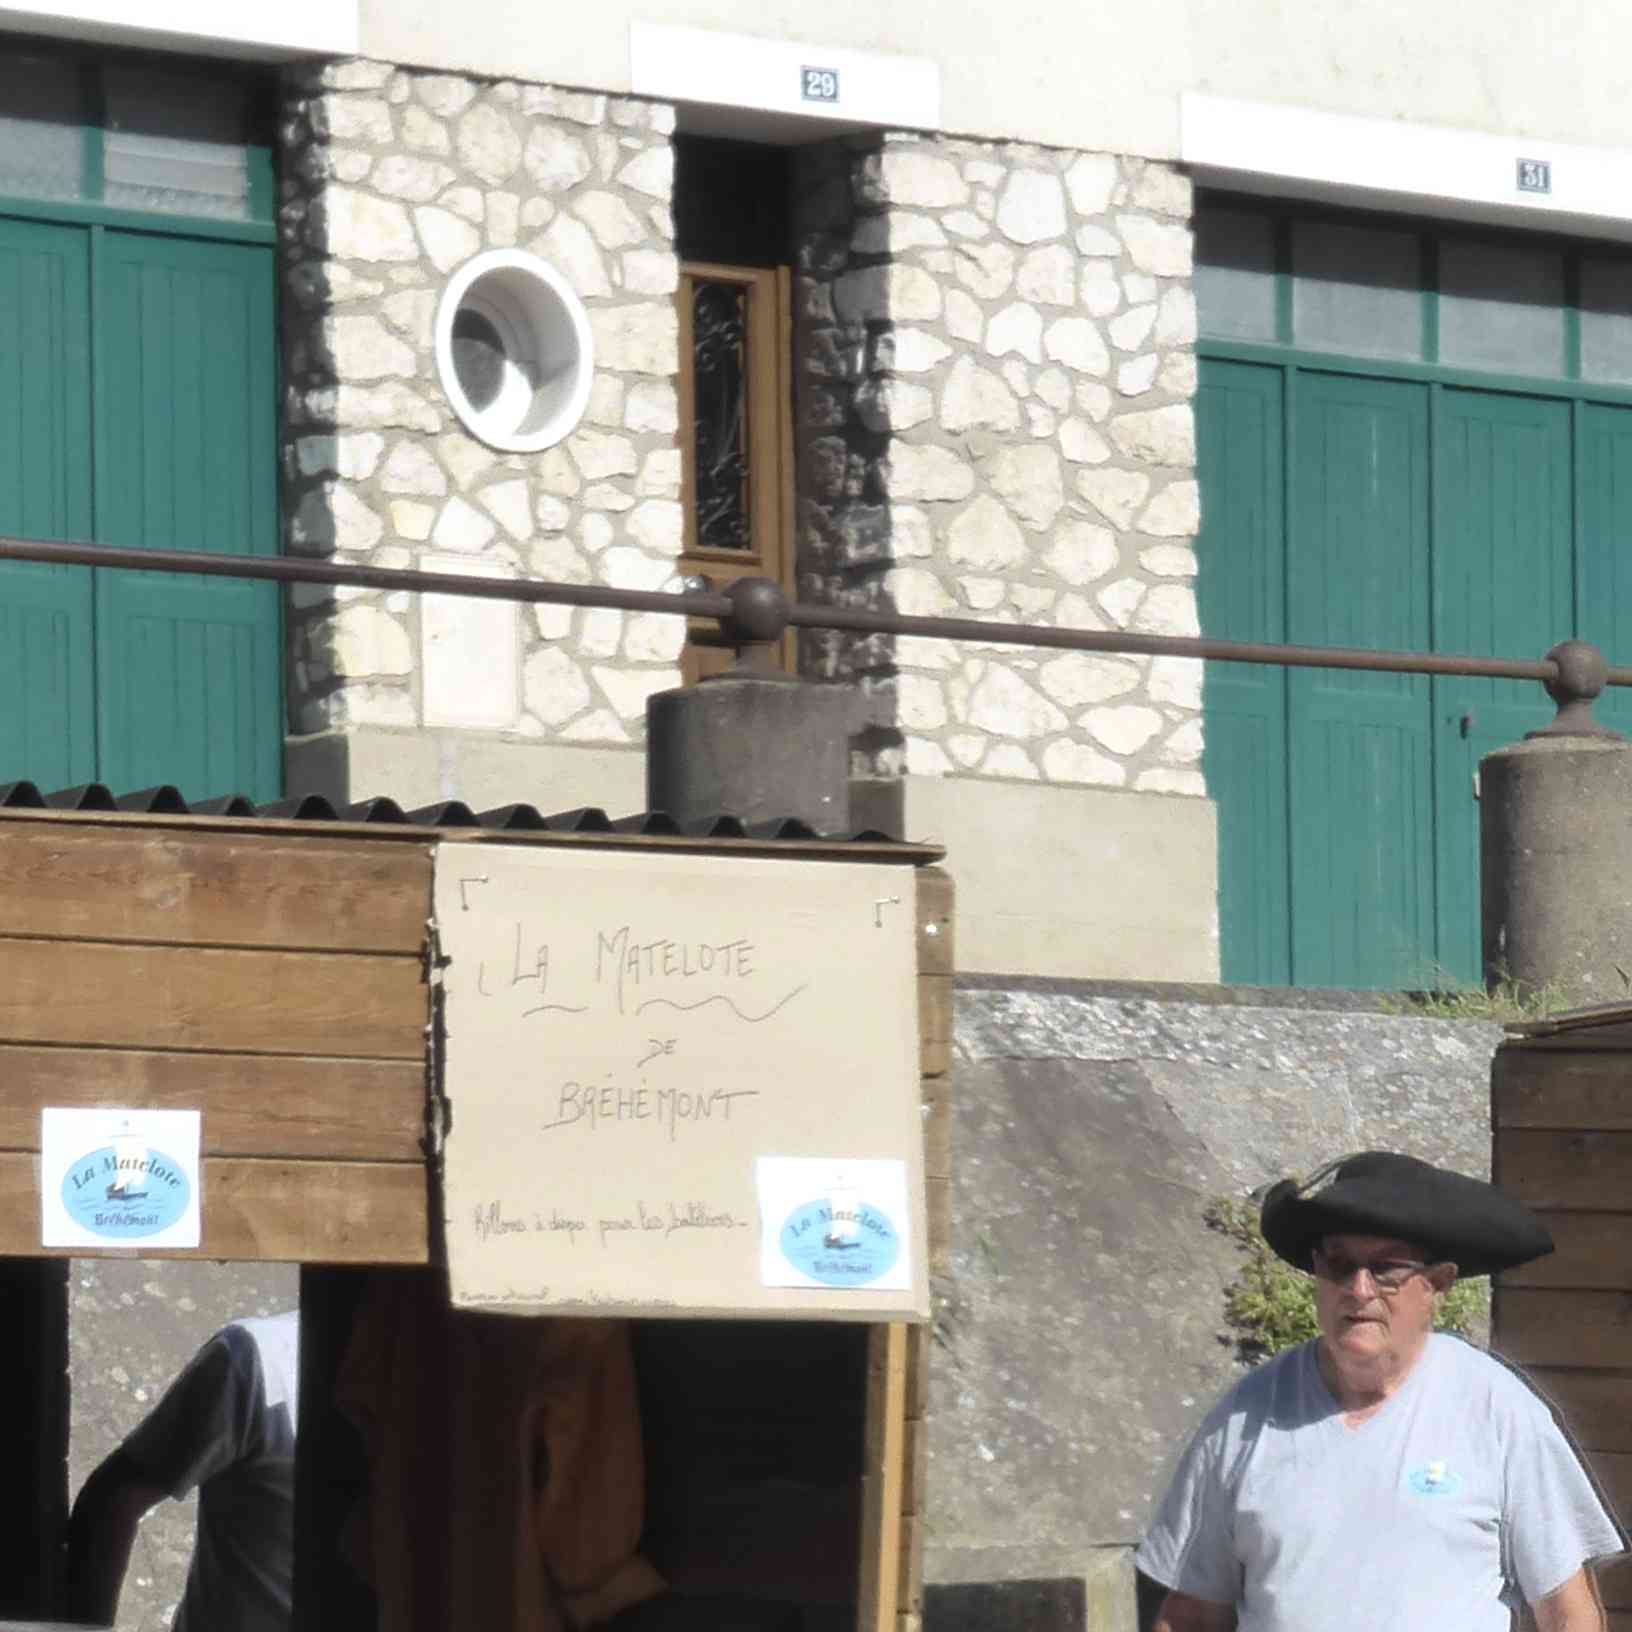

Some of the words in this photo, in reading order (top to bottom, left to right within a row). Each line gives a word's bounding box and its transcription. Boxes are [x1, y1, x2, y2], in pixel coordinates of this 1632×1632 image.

[806, 71, 836, 97] 29
[1524, 163, 1545, 188] 31
[512, 922, 549, 994] LA
[595, 926, 756, 1015] MATELOTE
[637, 1038, 678, 1068] DE
[71, 1167, 95, 1190] La
[102, 1155, 181, 1190] Matelote
